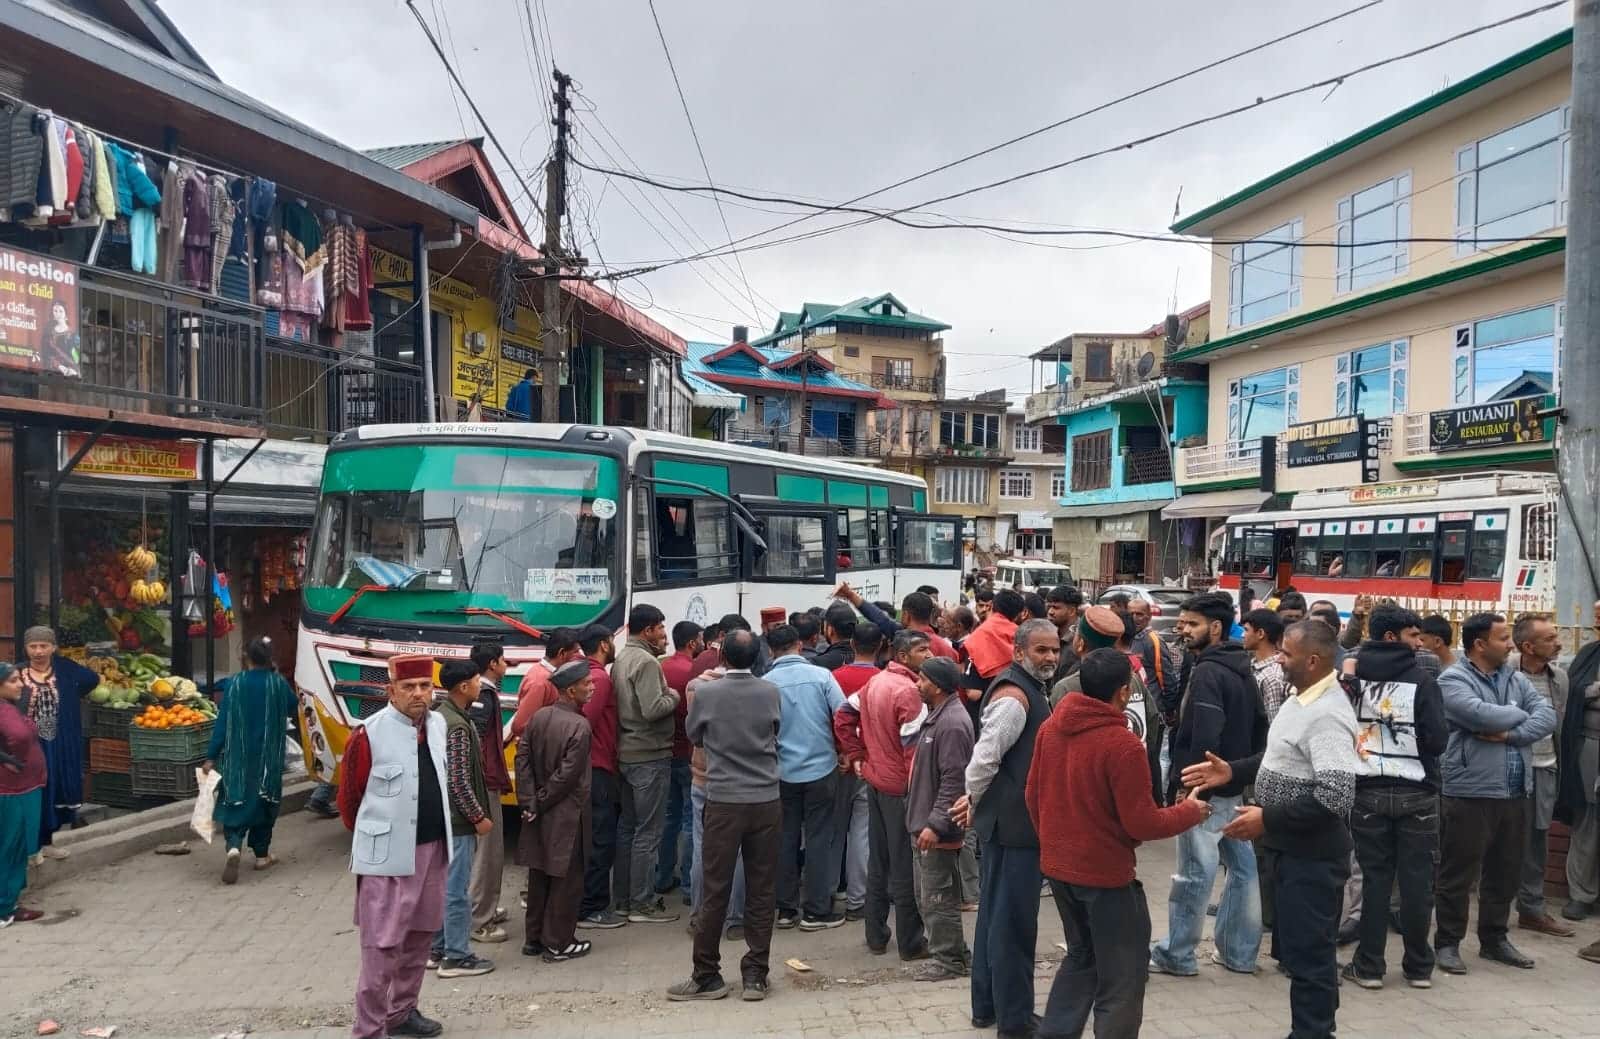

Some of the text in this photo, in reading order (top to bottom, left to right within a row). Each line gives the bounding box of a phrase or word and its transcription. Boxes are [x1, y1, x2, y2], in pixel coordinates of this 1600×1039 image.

[0, 252, 75, 285] llection
[28, 282, 54, 300] Child
[1456, 403, 1516, 427] JUMANJI
[1287, 424, 1315, 441] HOTEL
[1460, 422, 1511, 438] RESTAURANT
